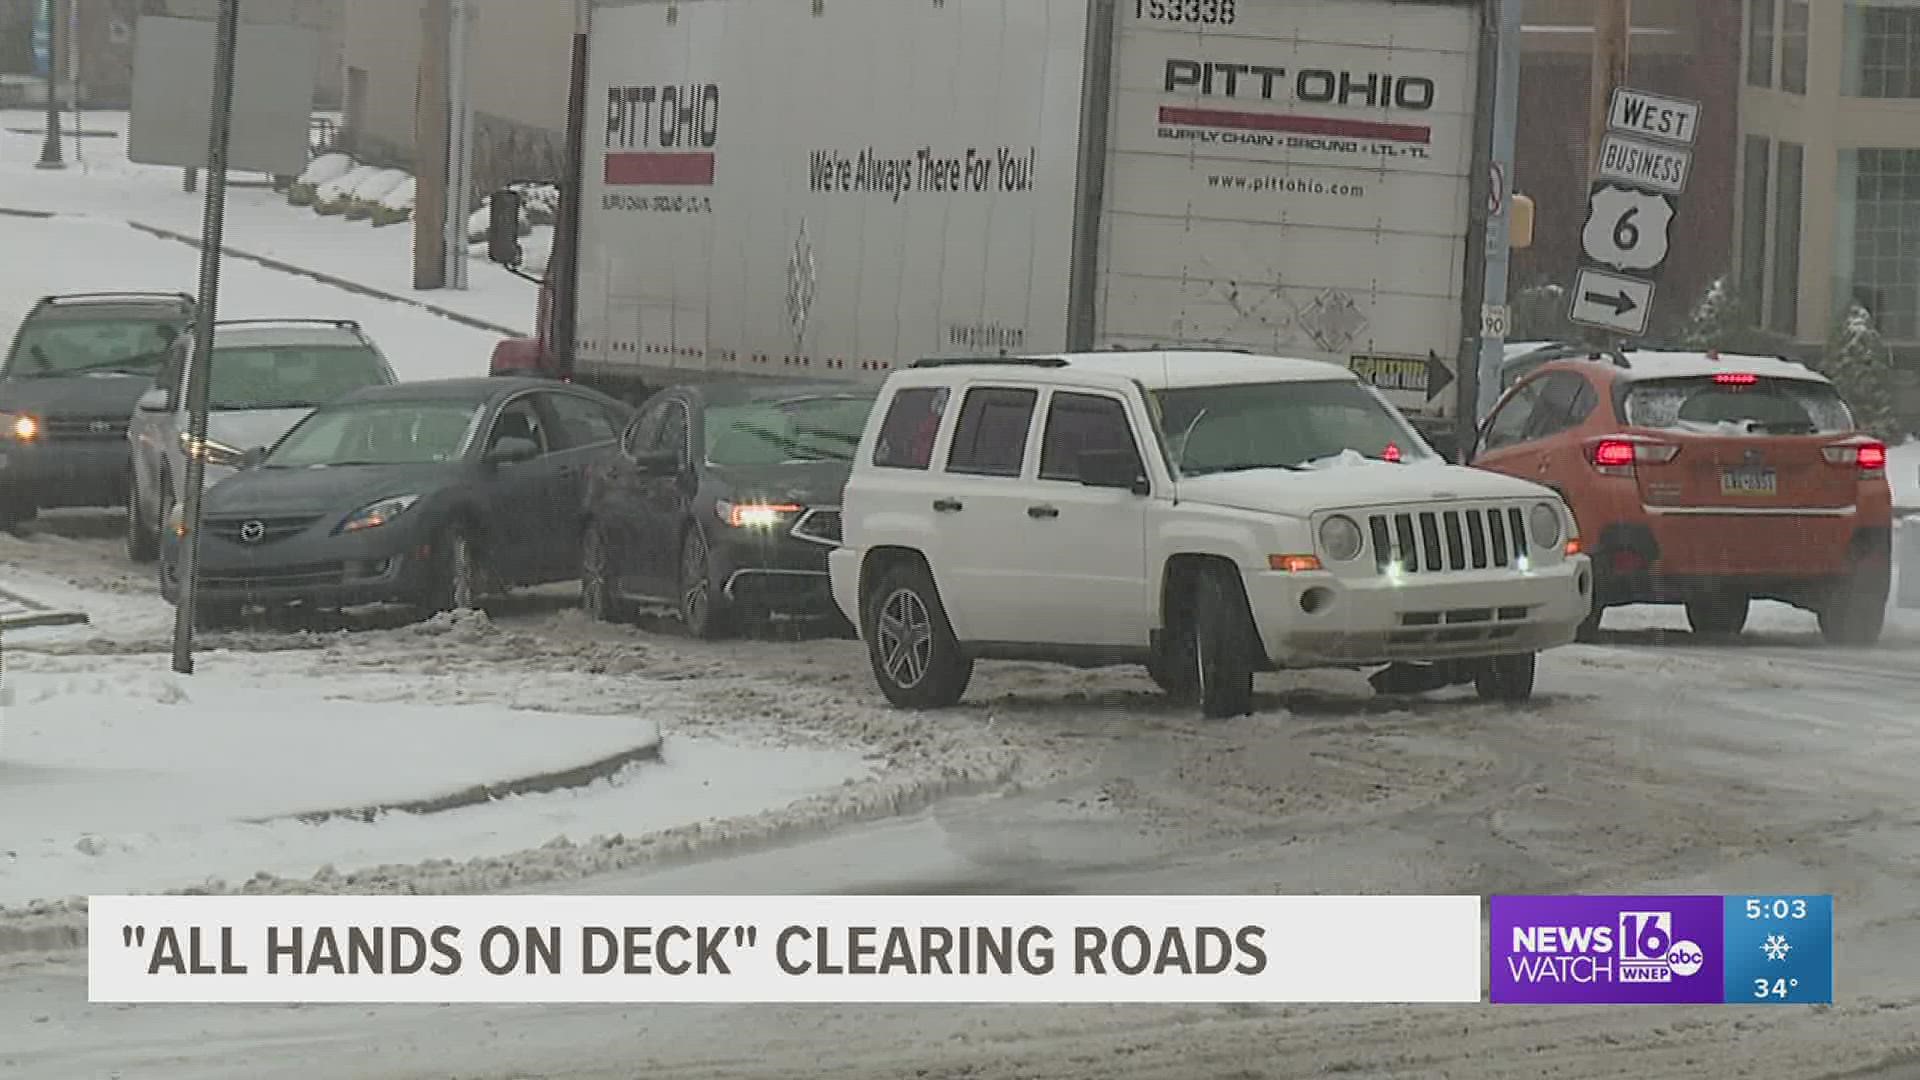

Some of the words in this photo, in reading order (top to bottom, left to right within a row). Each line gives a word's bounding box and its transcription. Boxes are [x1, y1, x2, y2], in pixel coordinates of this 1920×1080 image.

[1164, 58, 1286, 100] PITT
[1296, 68, 1435, 111] OHIO
[605, 85, 656, 147] PITT
[659, 83, 720, 147] OHIO
[1623, 97, 1689, 137] WEST
[1157, 127, 1220, 144] SUPPLY
[1221, 132, 1274, 148] CHAIN
[1287, 137, 1358, 153] GROUND
[1370, 143, 1399, 156] LTL
[808, 149, 852, 192] We're
[854, 145, 912, 204] Always
[915, 147, 961, 192] There
[963, 147, 992, 192] For
[997, 146, 1036, 192] You!
[1605, 143, 1683, 184] BUSINESS
[1207, 174, 1365, 198] www.pittohio.com
[1613, 206, 1640, 251] 6
